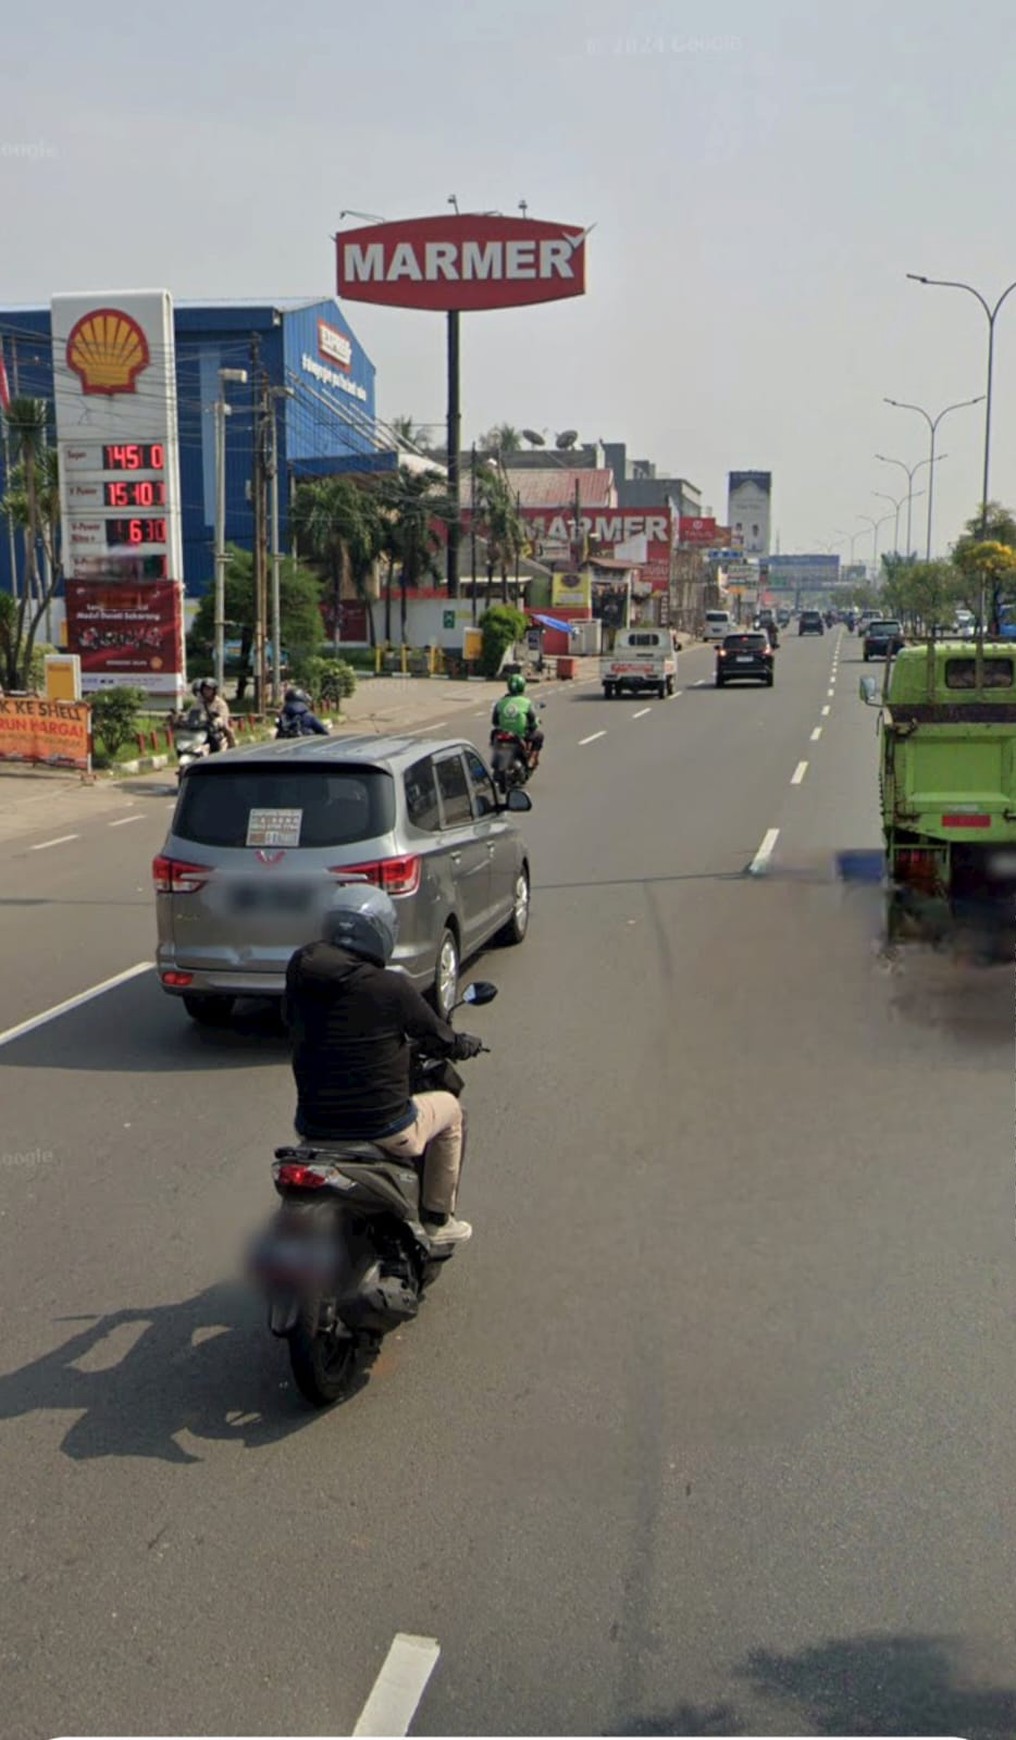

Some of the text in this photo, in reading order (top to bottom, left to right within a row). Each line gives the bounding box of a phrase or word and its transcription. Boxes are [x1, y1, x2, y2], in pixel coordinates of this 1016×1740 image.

[344, 240, 574, 282] MARMER
[16, 700, 35, 714] KE
[39, 702, 81, 721] SHELL
